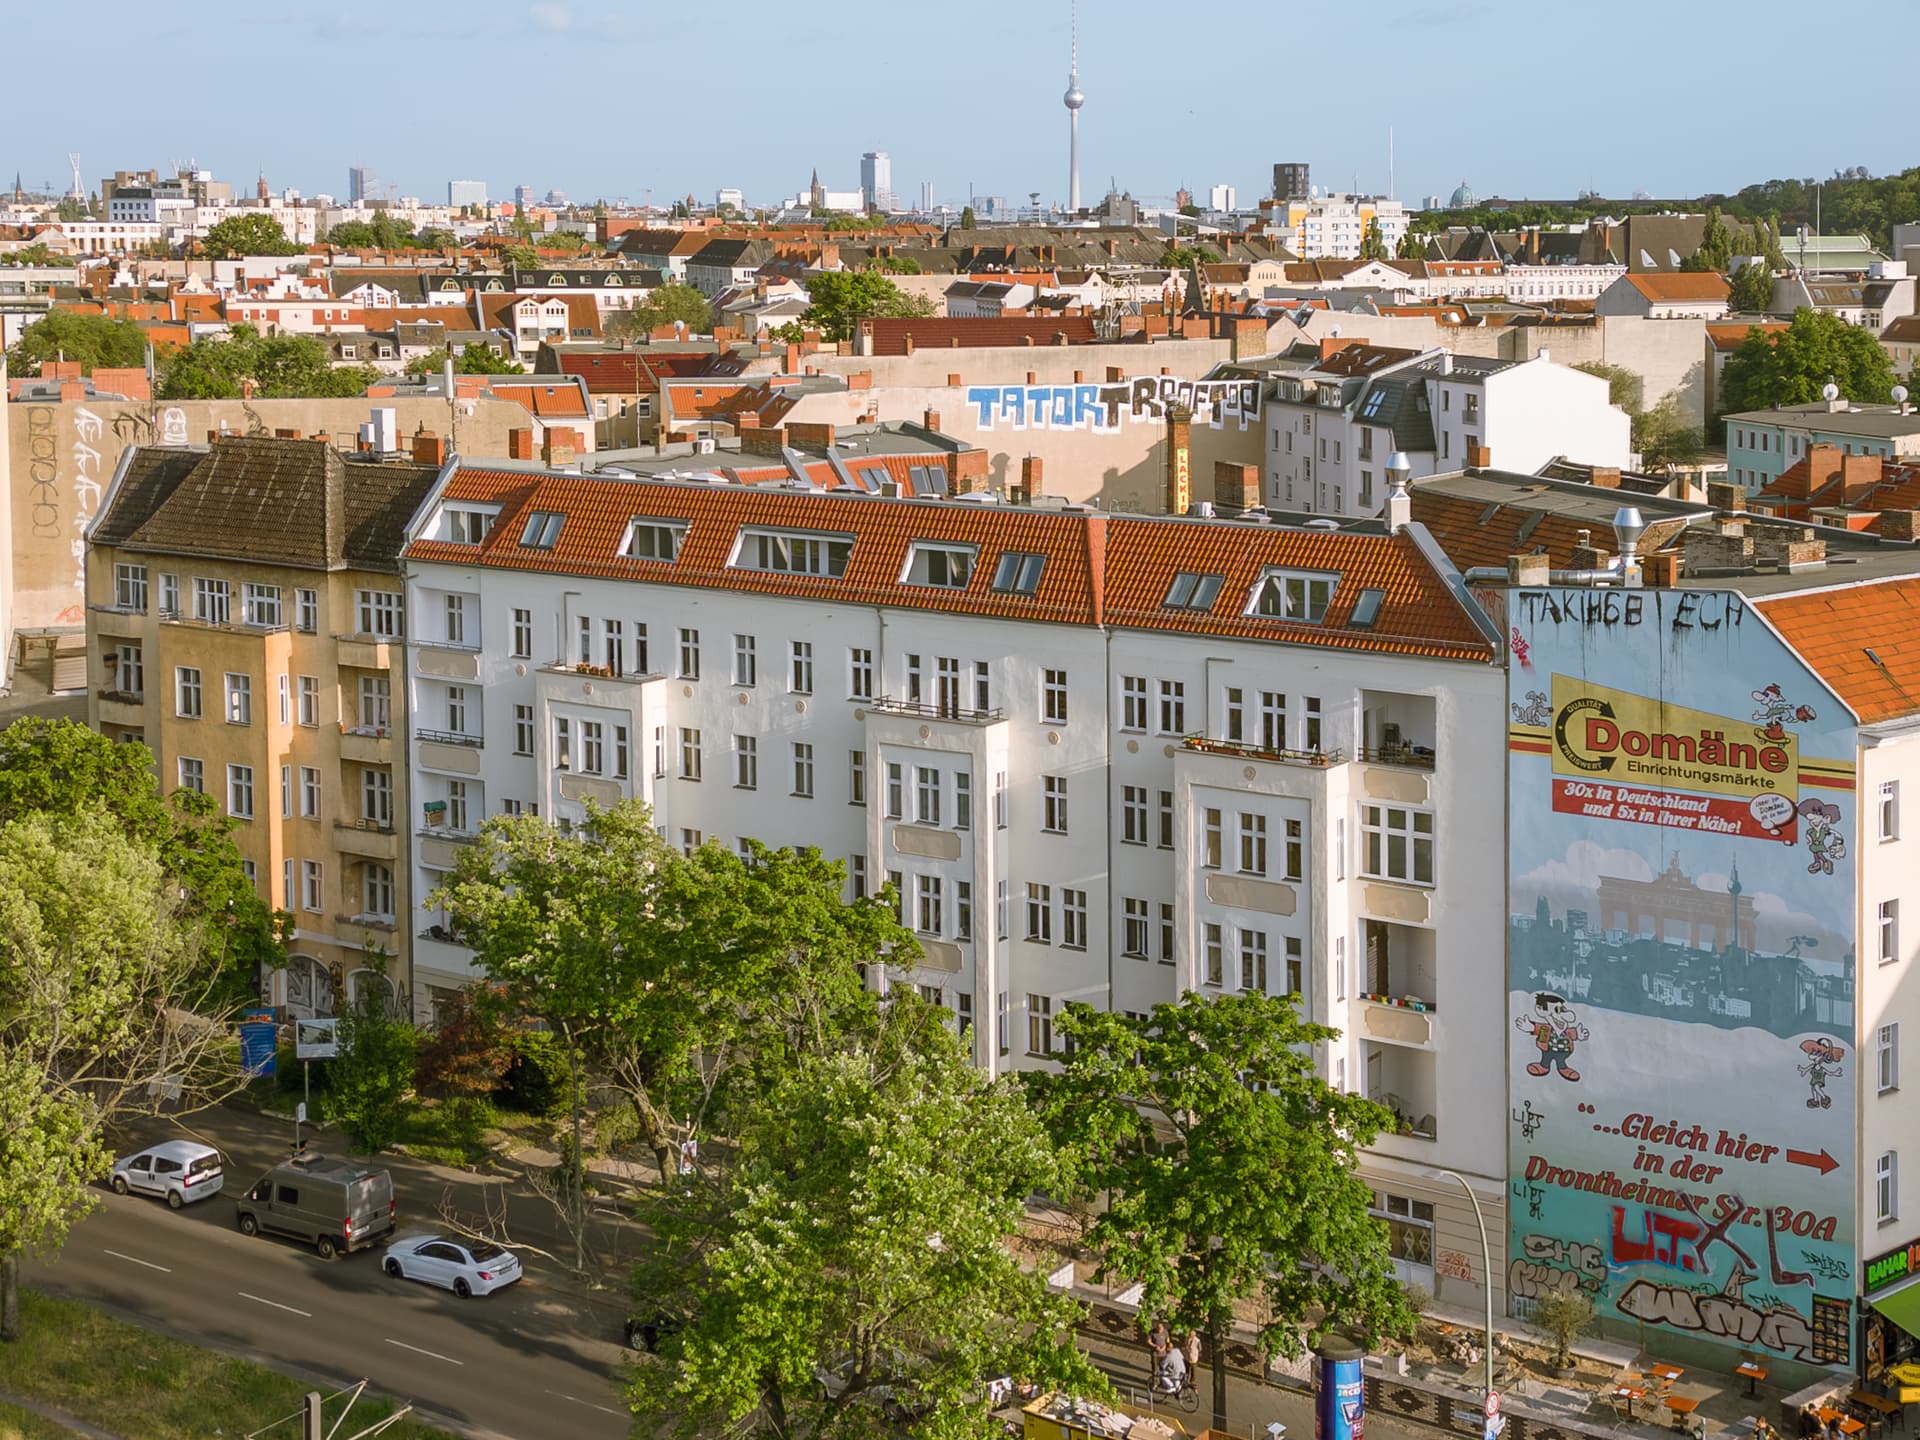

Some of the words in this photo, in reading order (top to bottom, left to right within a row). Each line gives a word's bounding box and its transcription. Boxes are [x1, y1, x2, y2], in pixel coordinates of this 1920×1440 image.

[1585, 717, 1790, 774] Domäne
[1627, 760, 1775, 789] Einrichtungsmärkte
[1563, 782, 1593, 798] 30x
[1595, 785, 1612, 801] in
[1616, 788, 1710, 813] Deutschland
[1582, 802, 1614, 818] und
[1616, 804, 1637, 821] 5x
[1638, 807, 1655, 822] in
[1657, 810, 1696, 828] Ihrer
[1697, 815, 1742, 834] Nähe!
[1714, 1129, 1779, 1164] hier
[1632, 1145, 1665, 1174] in
[1669, 1153, 1723, 1184] der
[1712, 1193, 1762, 1228] Sr.
[1774, 1205, 1838, 1242] 30A
